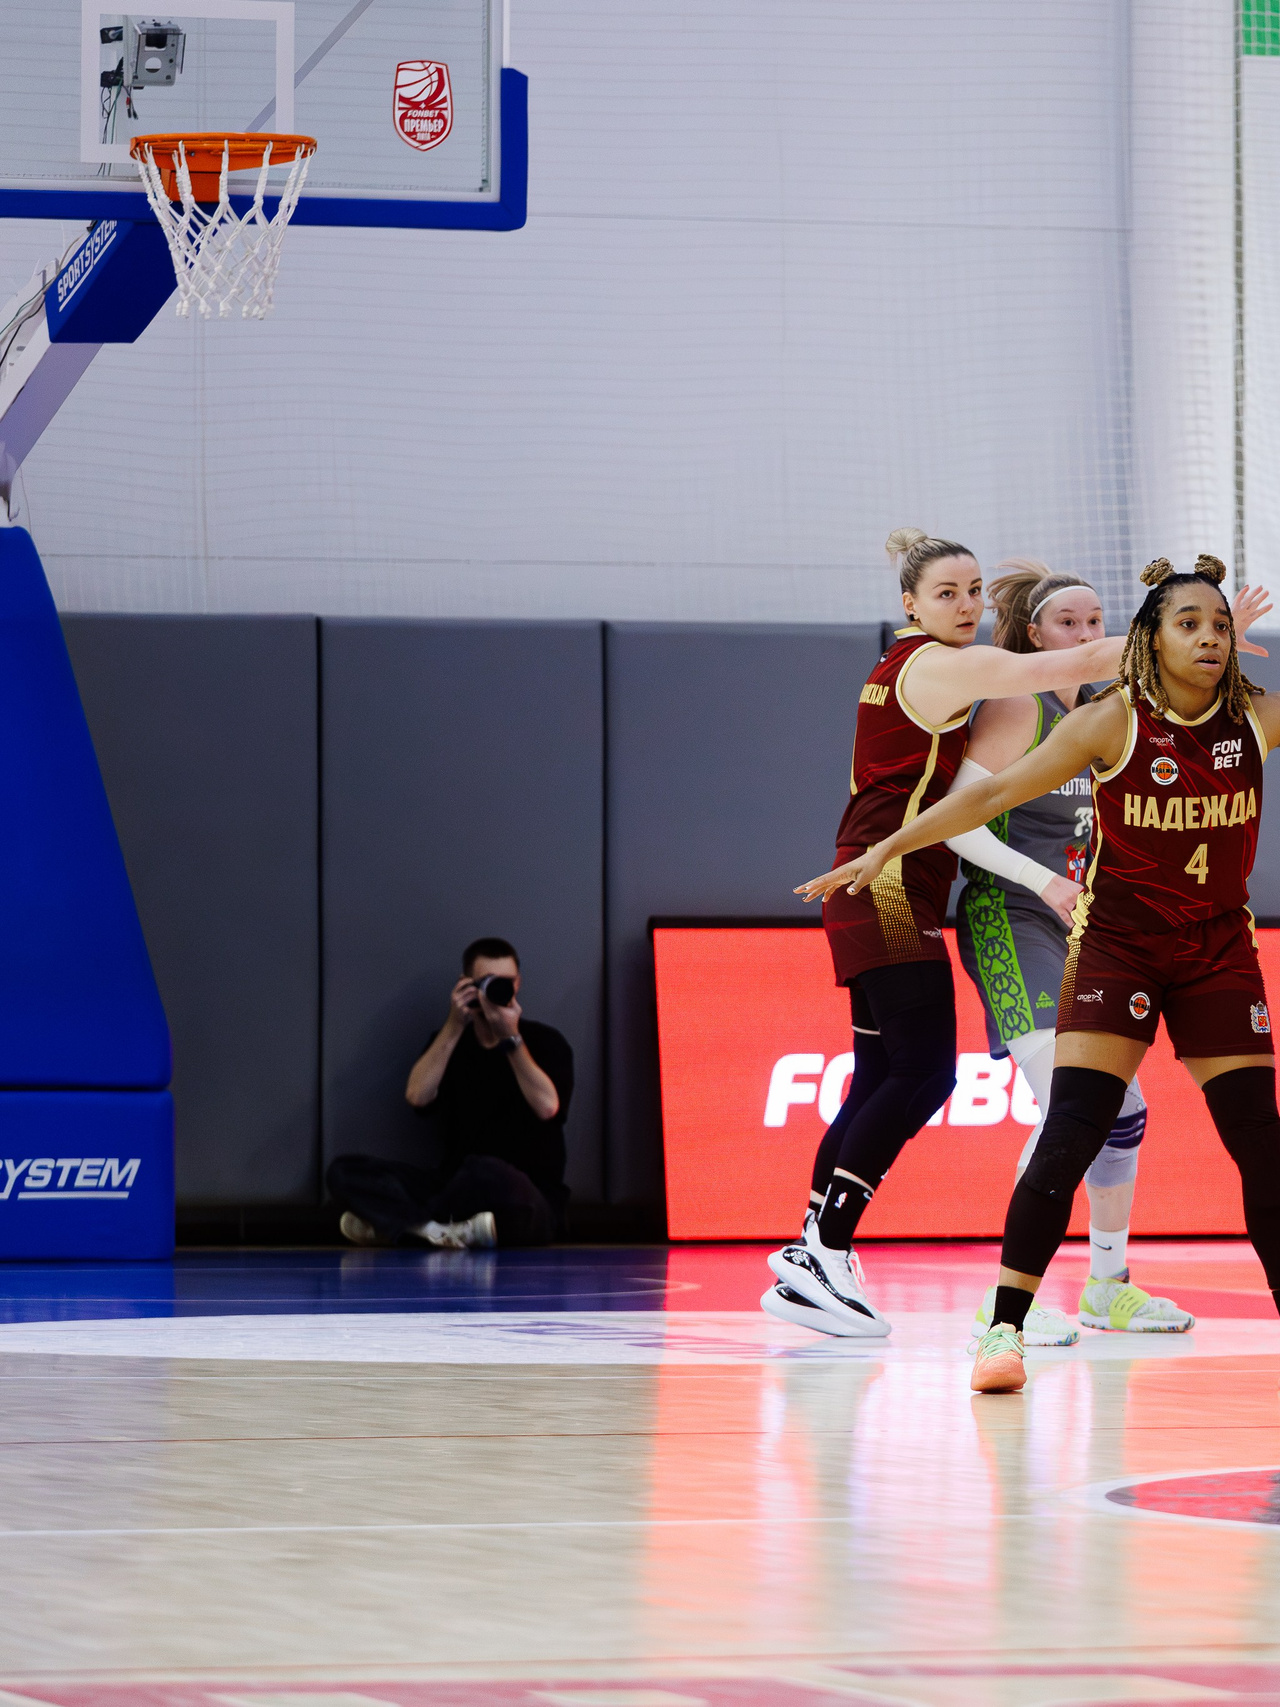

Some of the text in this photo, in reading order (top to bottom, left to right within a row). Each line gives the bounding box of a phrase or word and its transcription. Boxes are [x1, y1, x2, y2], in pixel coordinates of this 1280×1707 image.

[403, 118, 445, 133] ПРЕМЬЕР
[1211, 738, 1242, 756] FON
[1213, 752, 1243, 770] BET
[1123, 787, 1257, 832] НАДЕЖДА
[1183, 843, 1210, 885] 4
[0, 1157, 142, 1198] YSTEM
